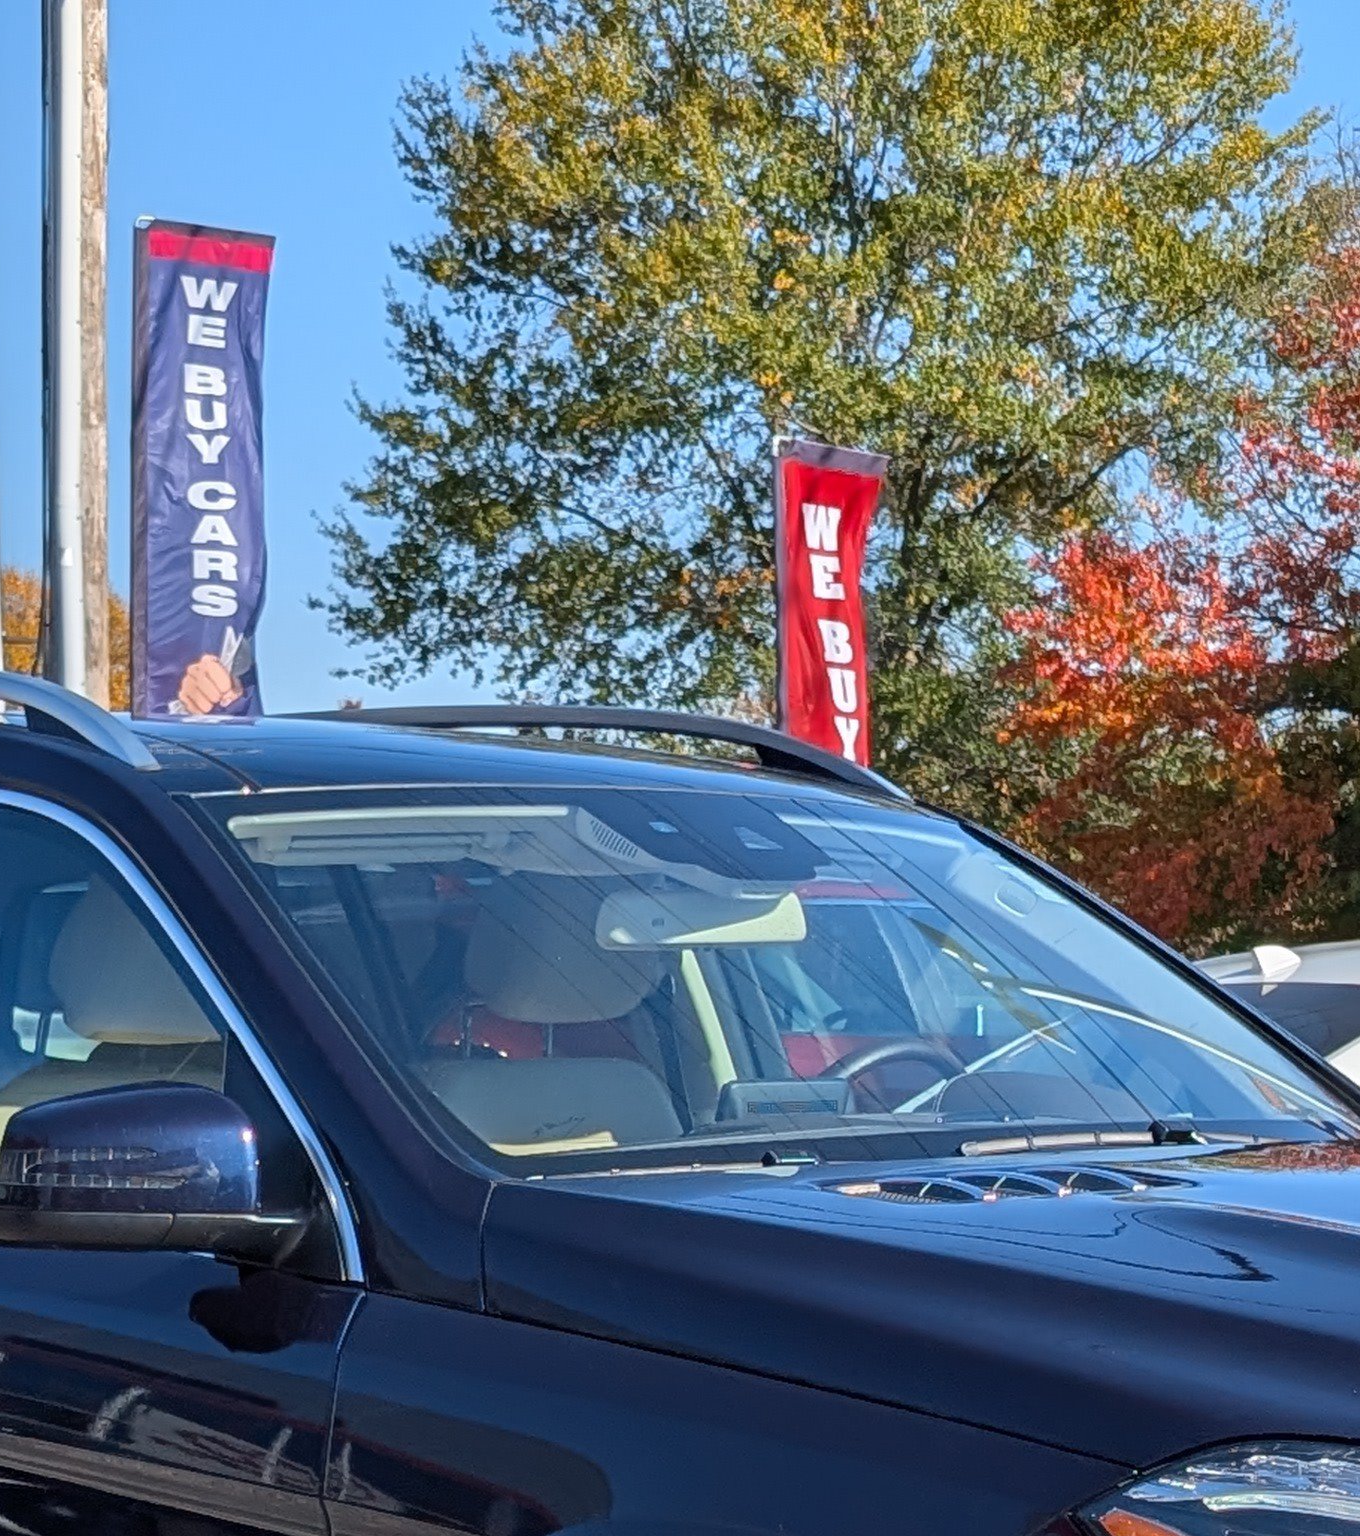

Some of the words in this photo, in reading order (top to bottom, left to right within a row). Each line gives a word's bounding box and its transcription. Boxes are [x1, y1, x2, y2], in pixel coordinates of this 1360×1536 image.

[180, 275, 238, 349] WE
[184, 363, 231, 464] BUY
[187, 481, 238, 618] CARS
[802, 502, 846, 601] WE
[817, 618, 859, 763] BUY
